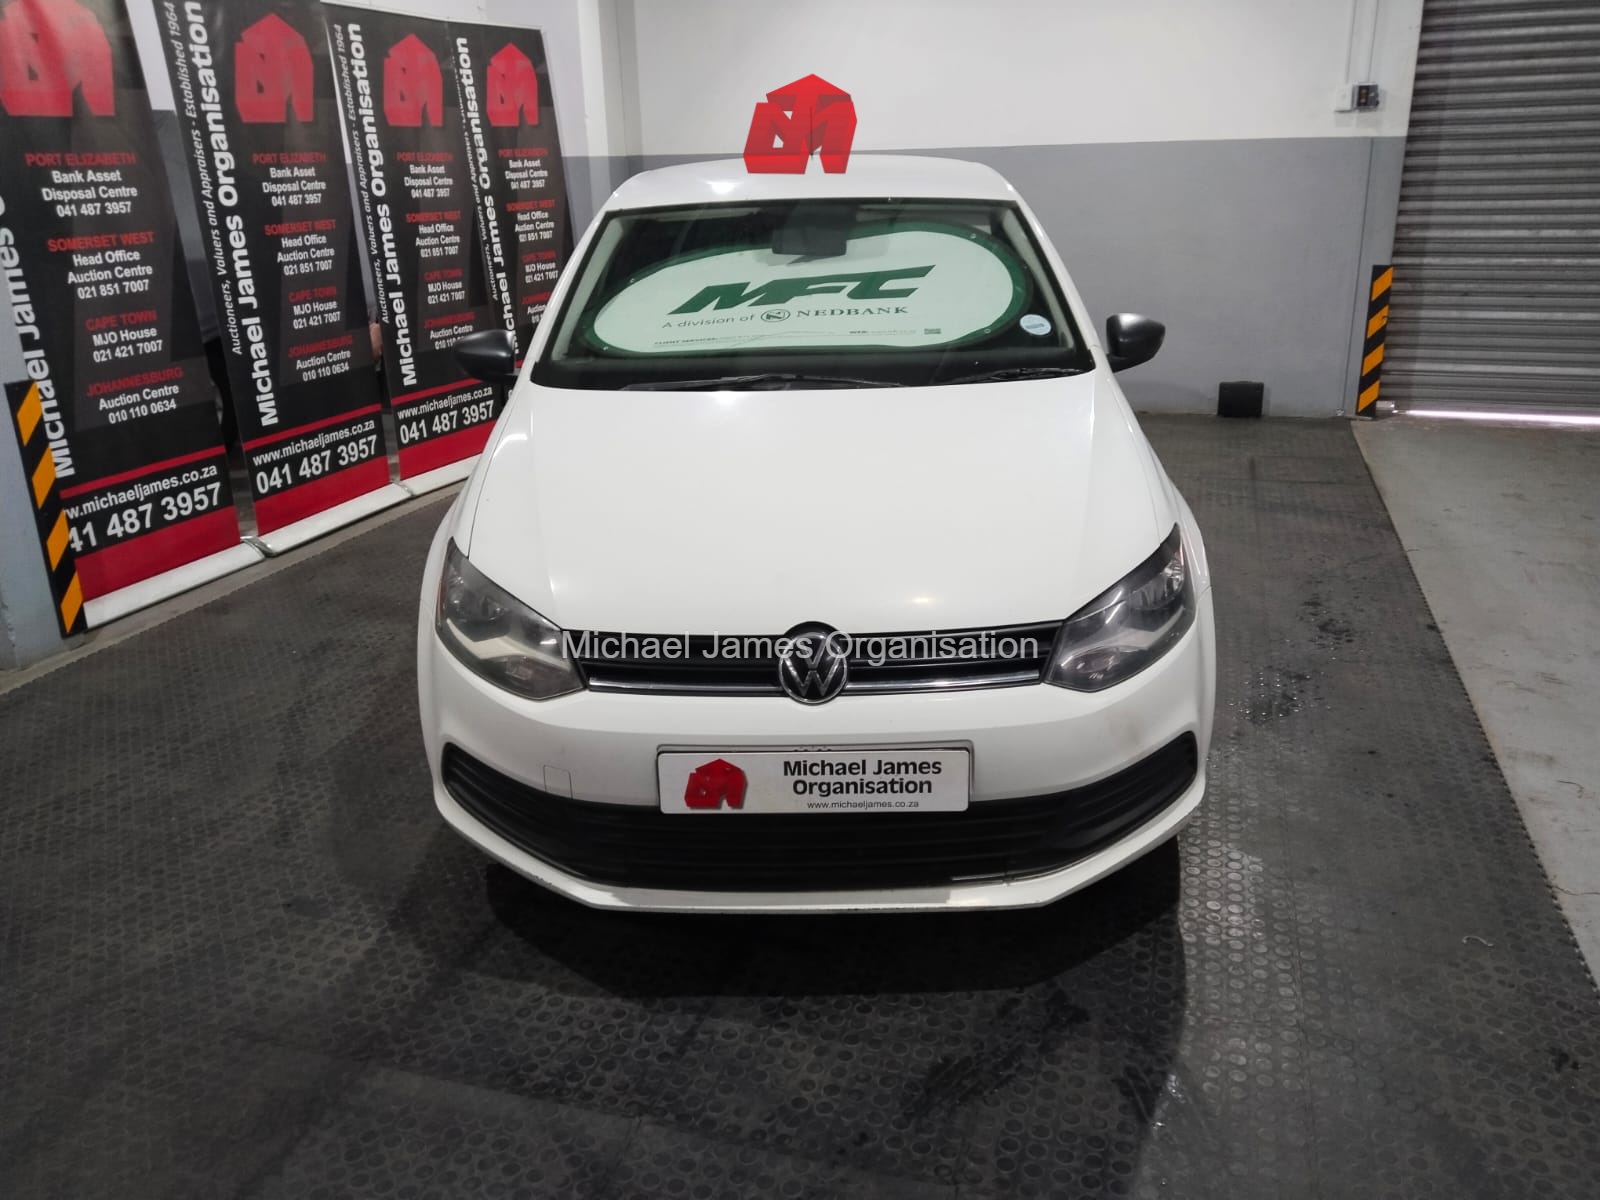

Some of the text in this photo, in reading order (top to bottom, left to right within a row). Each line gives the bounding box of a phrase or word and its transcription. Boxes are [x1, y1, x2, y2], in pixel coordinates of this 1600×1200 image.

[333, 23, 346, 53] 1964
[456, 37, 491, 190] Organisation
[25, 153, 137, 166] PORT ELIZABETH
[51, 169, 122, 184] Bank Asset
[164, 1, 243, 356] Auctioneers, Valuers and Appraisers Established 1964
[269, 166, 316, 178] Bank Asset
[42, 185, 138, 202] Disposal Centre
[262, 180, 327, 194] Disposal Centre
[56, 201, 132, 217] 041 487 3957
[271, 193, 322, 207] 041 487 3957
[347, 23, 417, 386] Michael James Organisation
[360, 190, 371, 213] and
[184, 1, 279, 428] Michael James Organisation
[47, 231, 155, 252] SOMERSET WEST
[281, 234, 327, 248] Head Office
[366, 215, 378, 255] Valuers
[415, 235, 461, 247] Auction Centre
[484, 195, 504, 267] James
[72, 249, 141, 268] Head Office
[277, 247, 335, 263] Auction Centre
[67, 263, 153, 285] Auction Centre
[283, 259, 333, 276] 021 851 7007
[0, 227, 40, 341] James
[77, 279, 150, 300] 021 851 7007
[374, 258, 390, 324] Auctioneers,
[442, 281, 462, 291] House
[668, 264, 937, 316] MFC
[293, 301, 338, 316] MJO House
[496, 272, 519, 354] chael
[796, 305, 910, 318] NEDBANK
[86, 310, 158, 331] CAPE TOWN
[293, 311, 341, 330] 021 421 7007
[662, 313, 755, 329] A division of
[93, 326, 158, 347] MJO House
[429, 328, 453, 340] Auction
[92, 339, 164, 364] 021 421 7007
[296, 350, 351, 370] Auction Centre
[302, 361, 350, 382] 010 110 0634
[99, 383, 180, 411] Auction Centre
[397, 386, 493, 420] www.michaeljames.co.za
[108, 398, 177, 425] 010 110 0634
[400, 400, 495, 444] 041 487 3957
[252, 419, 375, 467] www.michaeljames.co.za
[255, 434, 378, 494] 041 487 3957
[64, 464, 218, 520] w.michaeljames.co.za
[106, 503, 153, 539] 487
[163, 481, 221, 521] 3957
[783, 760, 942, 776] Michael James
[792, 778, 932, 797] Organisation
[807, 800, 919, 810] www.michaeljames.co.za
